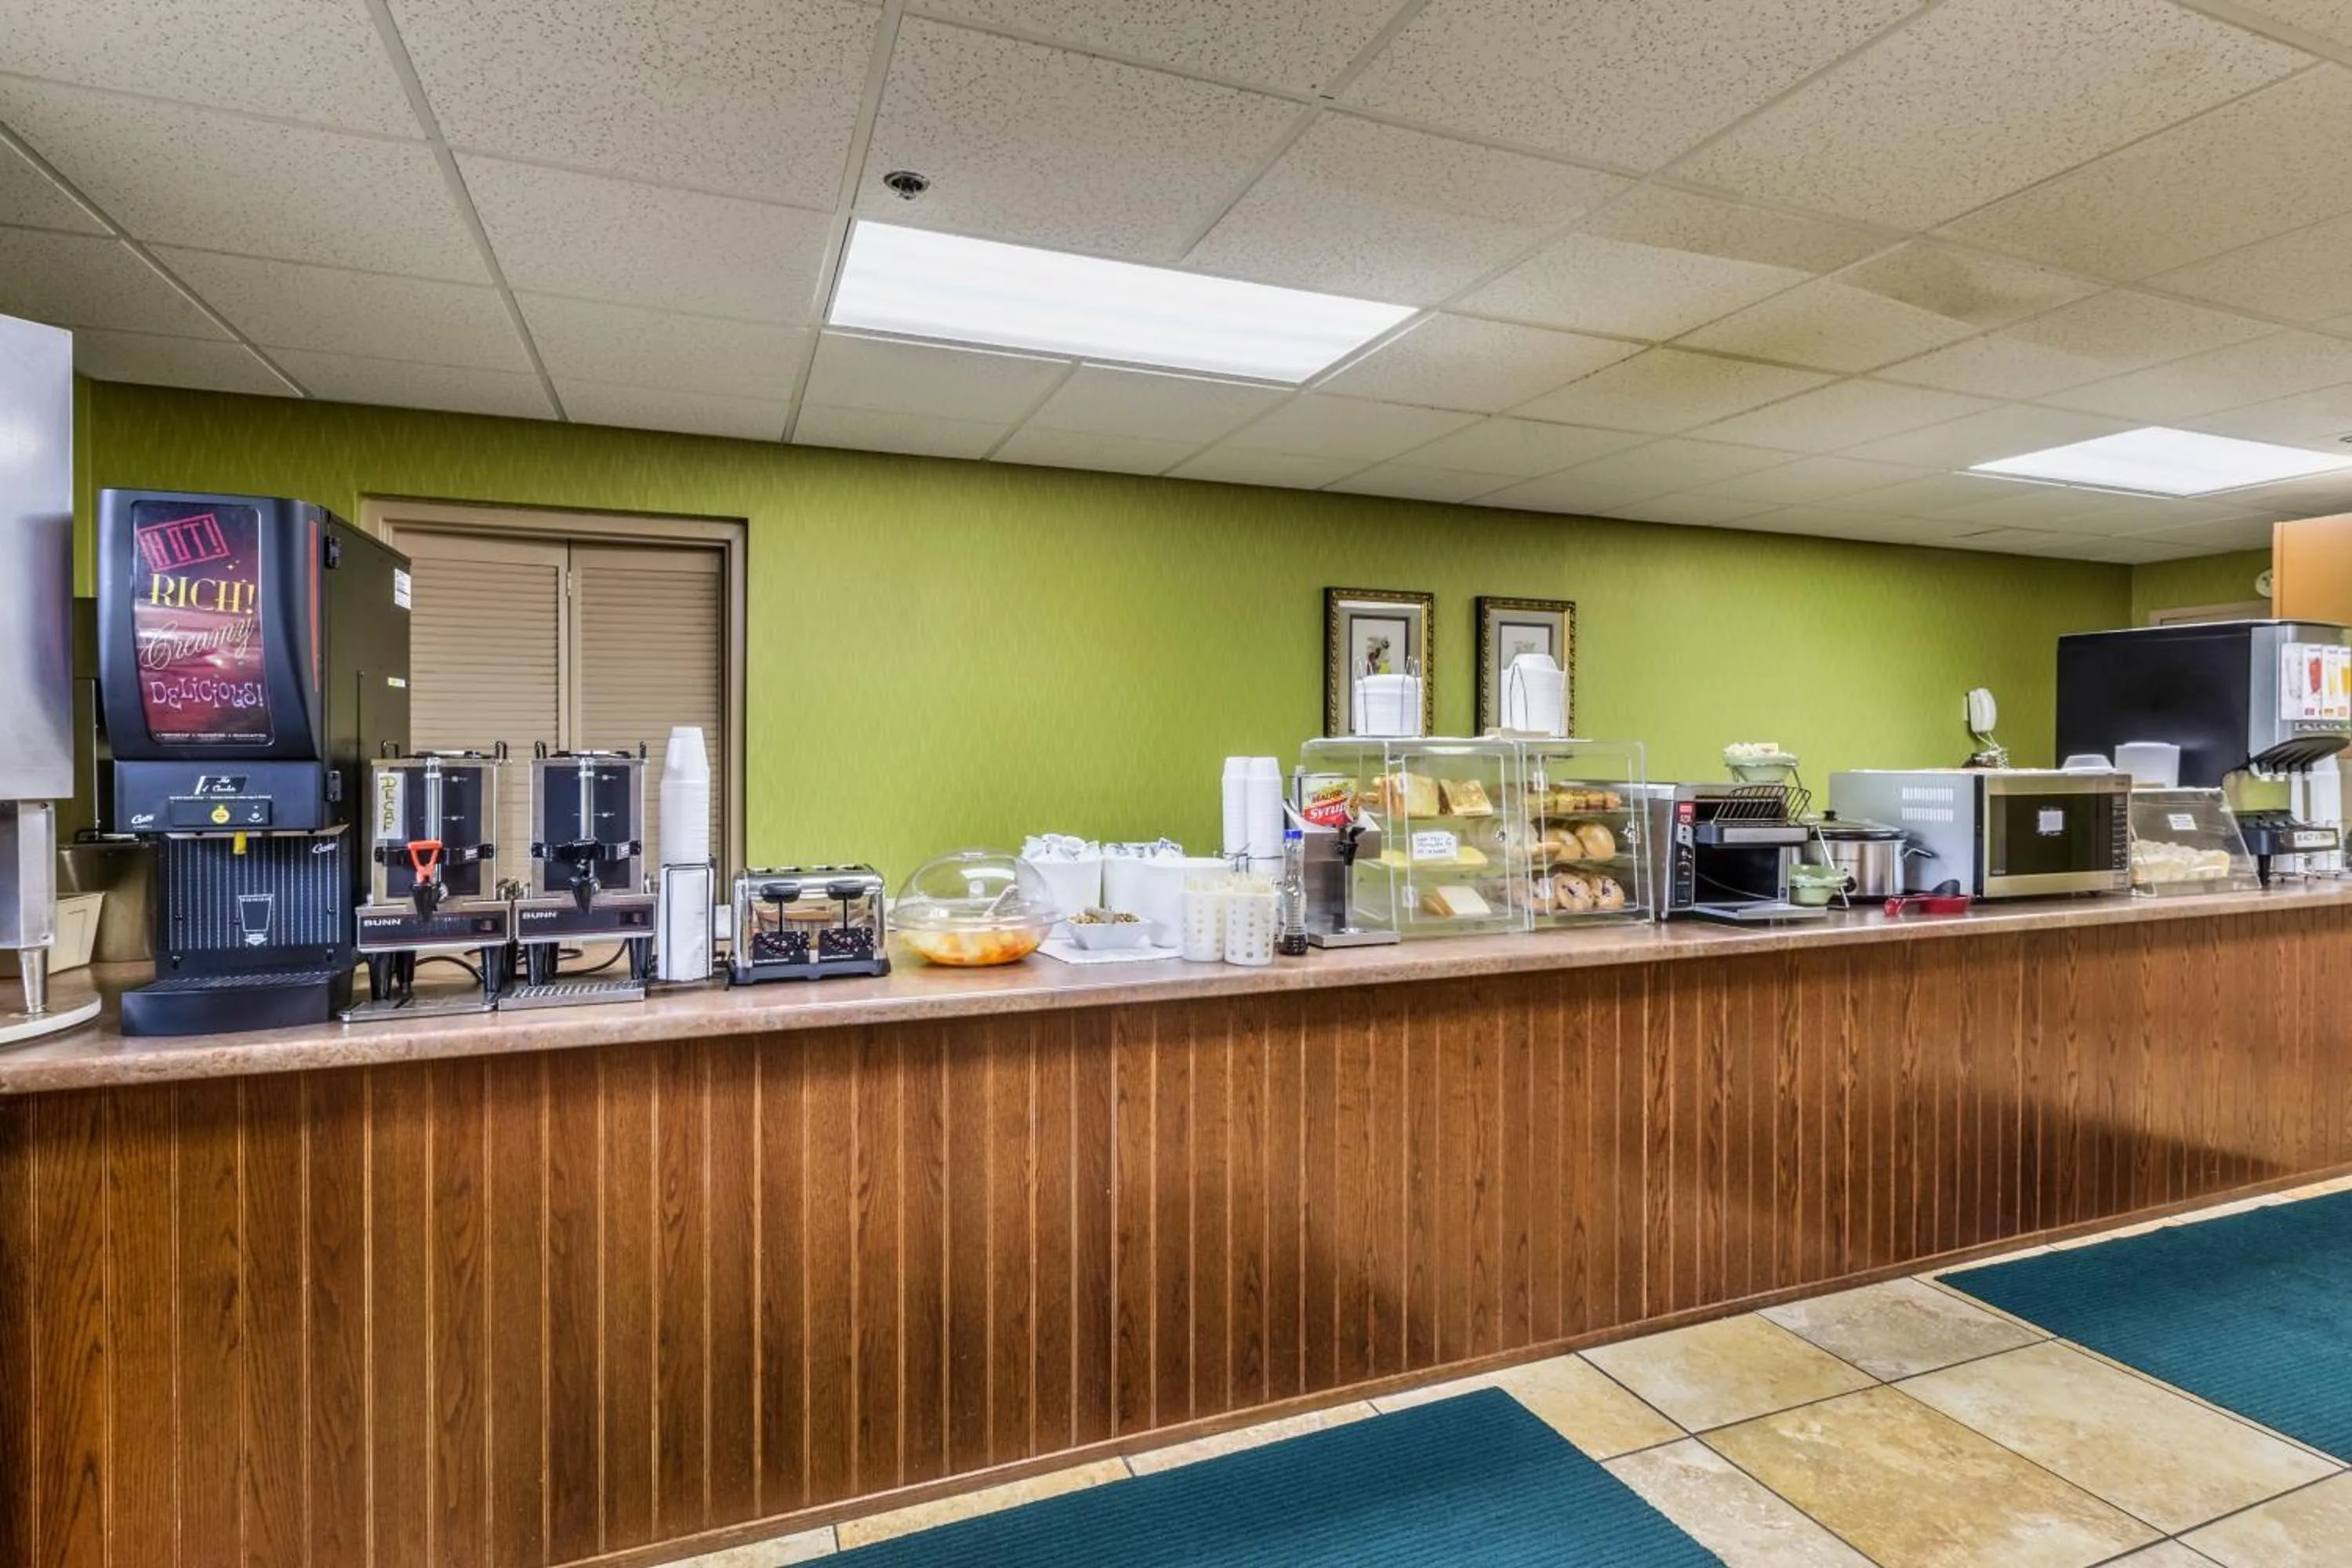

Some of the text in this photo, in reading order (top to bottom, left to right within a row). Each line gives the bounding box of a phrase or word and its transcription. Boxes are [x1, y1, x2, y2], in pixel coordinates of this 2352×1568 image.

[151, 573, 256, 614] RICH!
[140, 616, 254, 670] Creamy
[363, 918, 401, 927] BUNN
